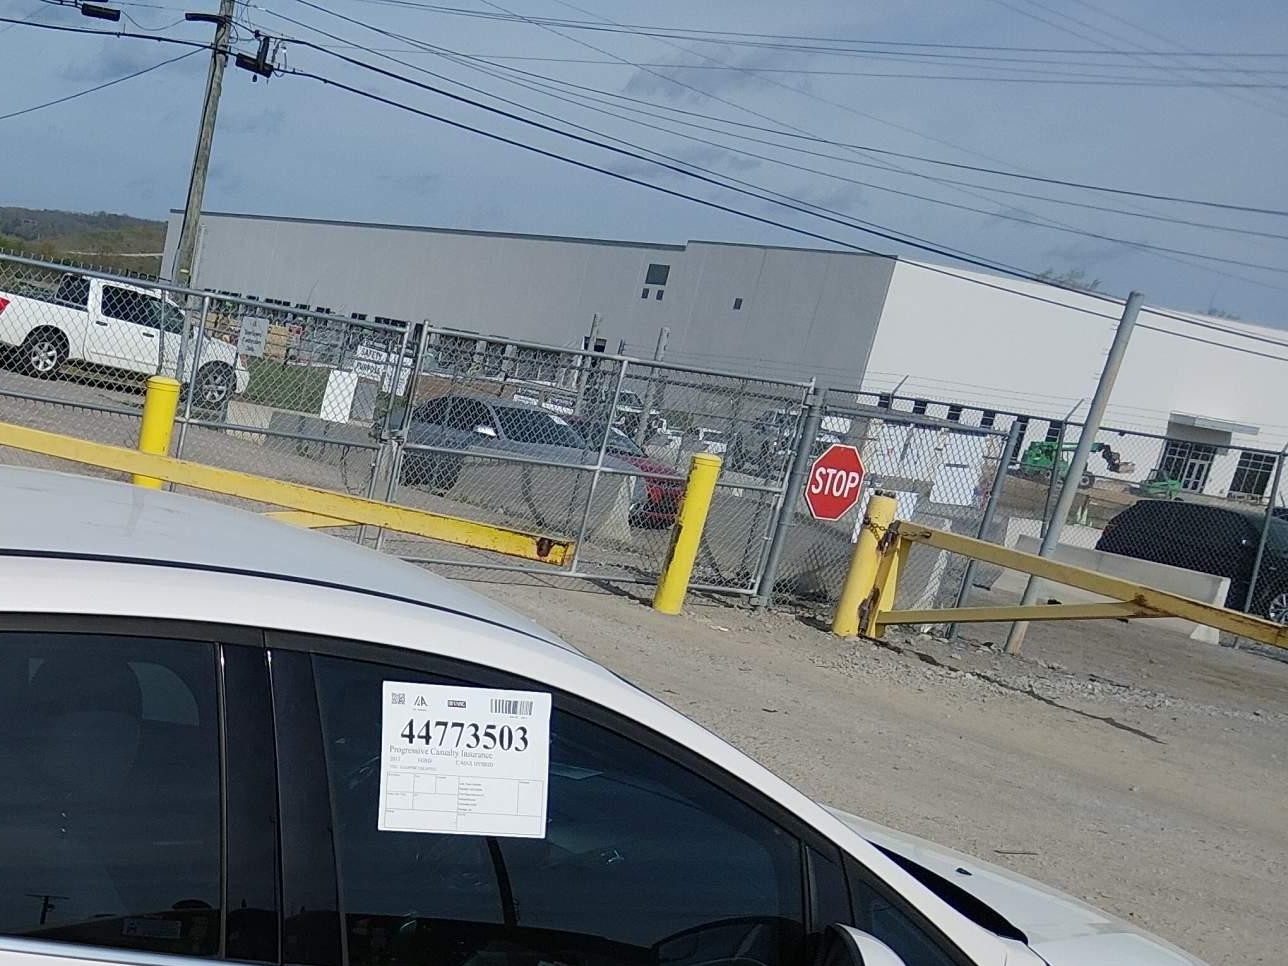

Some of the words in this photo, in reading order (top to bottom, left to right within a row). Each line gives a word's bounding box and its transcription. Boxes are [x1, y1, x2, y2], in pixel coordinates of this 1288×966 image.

[361, 347, 384, 361] SAFETY
[811, 466, 860, 498] STOP
[400, 718, 529, 752] 44773503
[389, 744, 429, 755] Progressive
[430, 747, 459, 758] Casualty
[461, 749, 494, 760] Insurance
